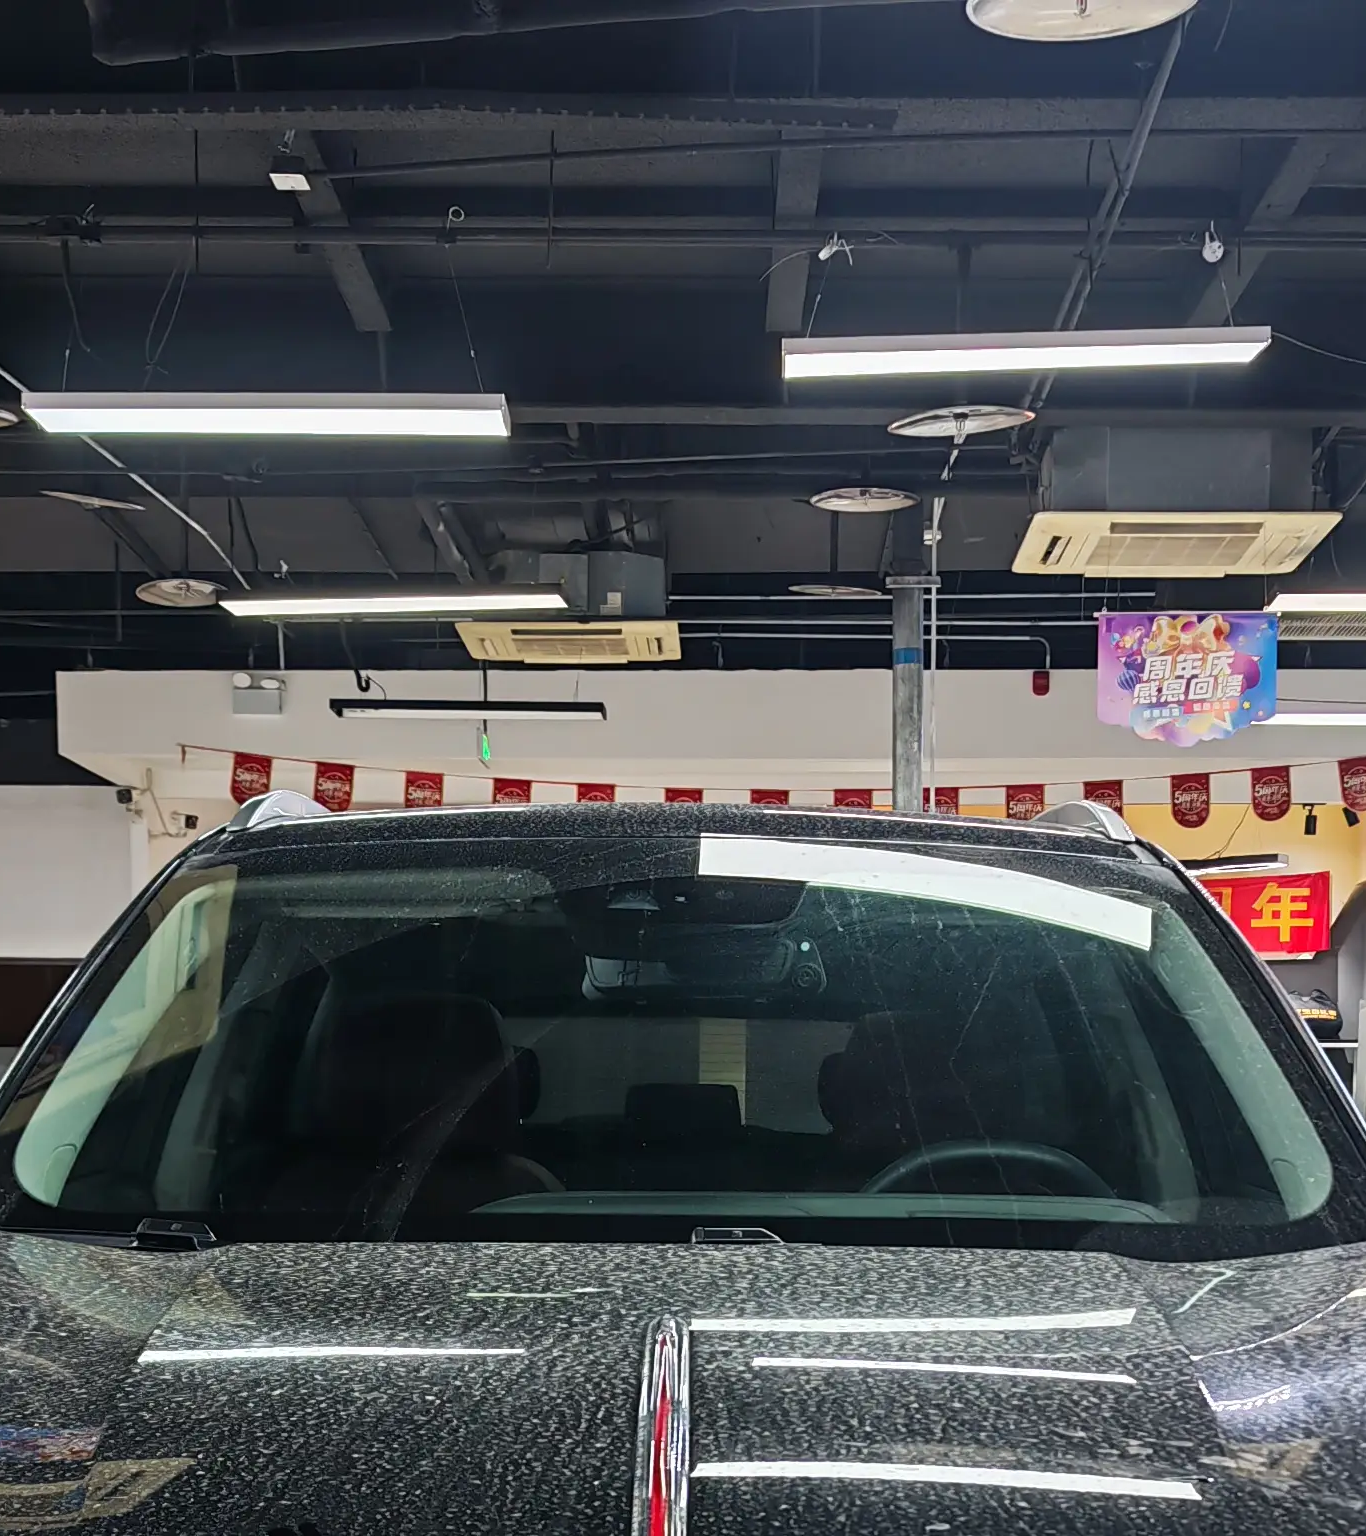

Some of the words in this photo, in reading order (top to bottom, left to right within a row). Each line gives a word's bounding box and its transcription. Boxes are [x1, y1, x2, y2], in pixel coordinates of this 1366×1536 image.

[1143, 651, 1235, 681] 周年庆
[1133, 674, 1244, 704] 感恩回馈
